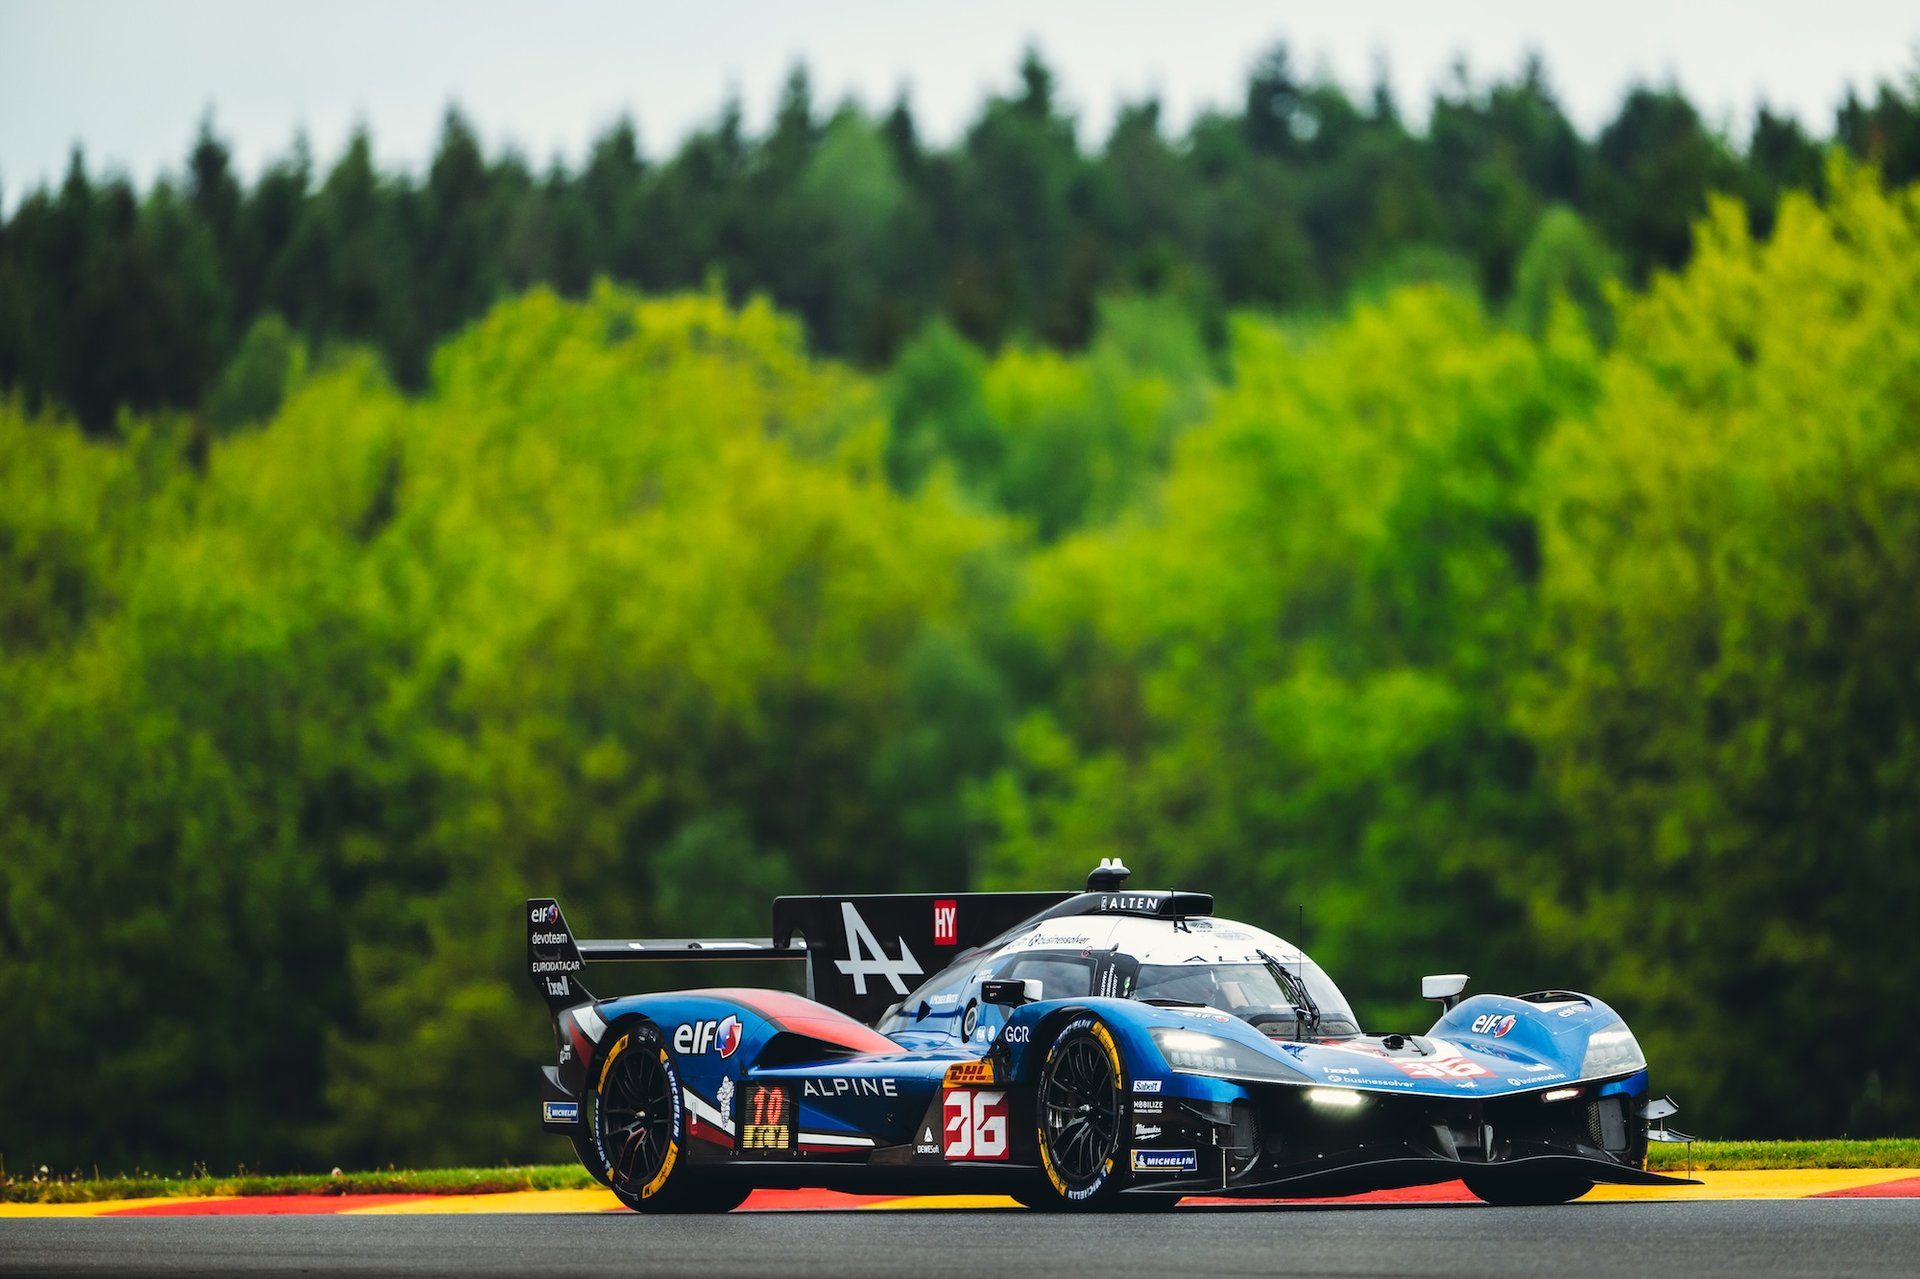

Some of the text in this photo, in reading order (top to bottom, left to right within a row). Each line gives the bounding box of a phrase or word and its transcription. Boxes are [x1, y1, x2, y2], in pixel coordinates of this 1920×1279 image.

[1110, 898, 1158, 910] ALTEN
[531, 907, 548, 922] elf
[935, 907, 956, 938] HY
[532, 931, 568, 944] devoteam
[532, 960, 580, 973] EURODATACAR
[546, 975, 570, 995] ixell
[1471, 1014, 1502, 1034] elf
[673, 1021, 717, 1054] elf
[1005, 1025, 1030, 1043] GCR
[950, 1065, 987, 1080] DHL
[804, 1078, 898, 1097] ALPINE
[1135, 1081, 1158, 1091] Sabelt
[1342, 1076, 1415, 1088] businessolver
[666, 1070, 681, 1138] MICHELIN
[753, 1086, 784, 1125] 10
[552, 1109, 577, 1117] MICHELIN
[943, 1090, 1007, 1157] 36
[1147, 1157, 1195, 1166] MICHELIN
